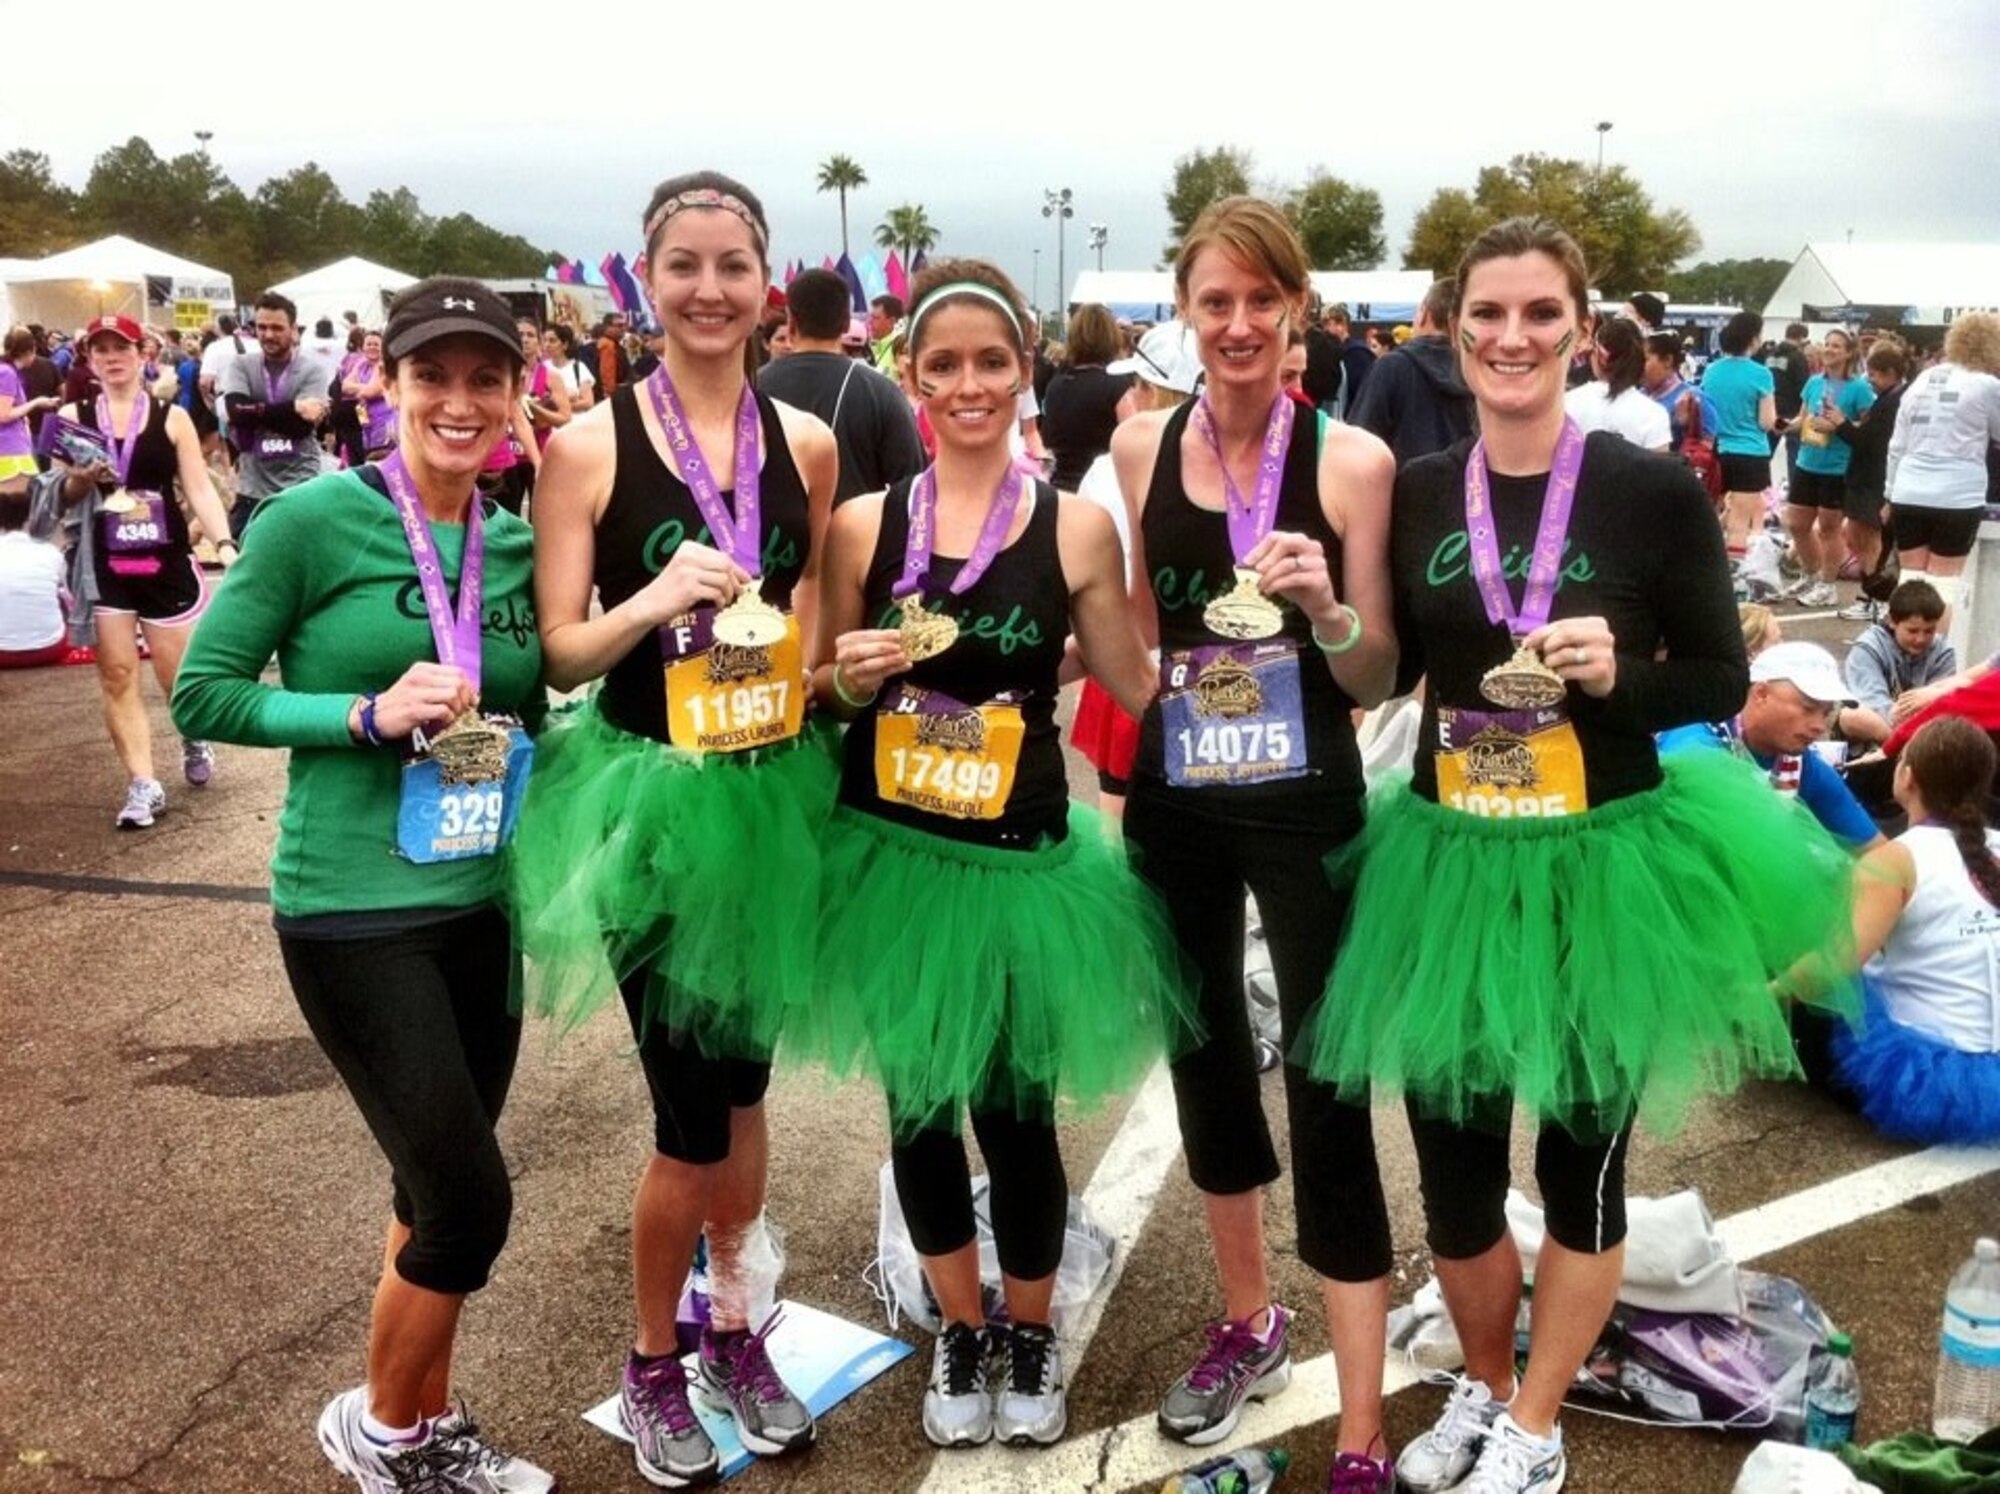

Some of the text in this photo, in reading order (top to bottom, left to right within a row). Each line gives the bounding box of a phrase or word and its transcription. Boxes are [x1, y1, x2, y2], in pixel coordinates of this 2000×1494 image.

[116, 523, 159, 541] 4349
[675, 627, 692, 654] F
[1170, 664, 1188, 687] G
[684, 680, 788, 733] 11957
[412, 727, 432, 752] A
[1178, 722, 1291, 765] 14075
[1439, 722, 1453, 749] E
[892, 748, 999, 799] 17499
[440, 791, 503, 837] 329
